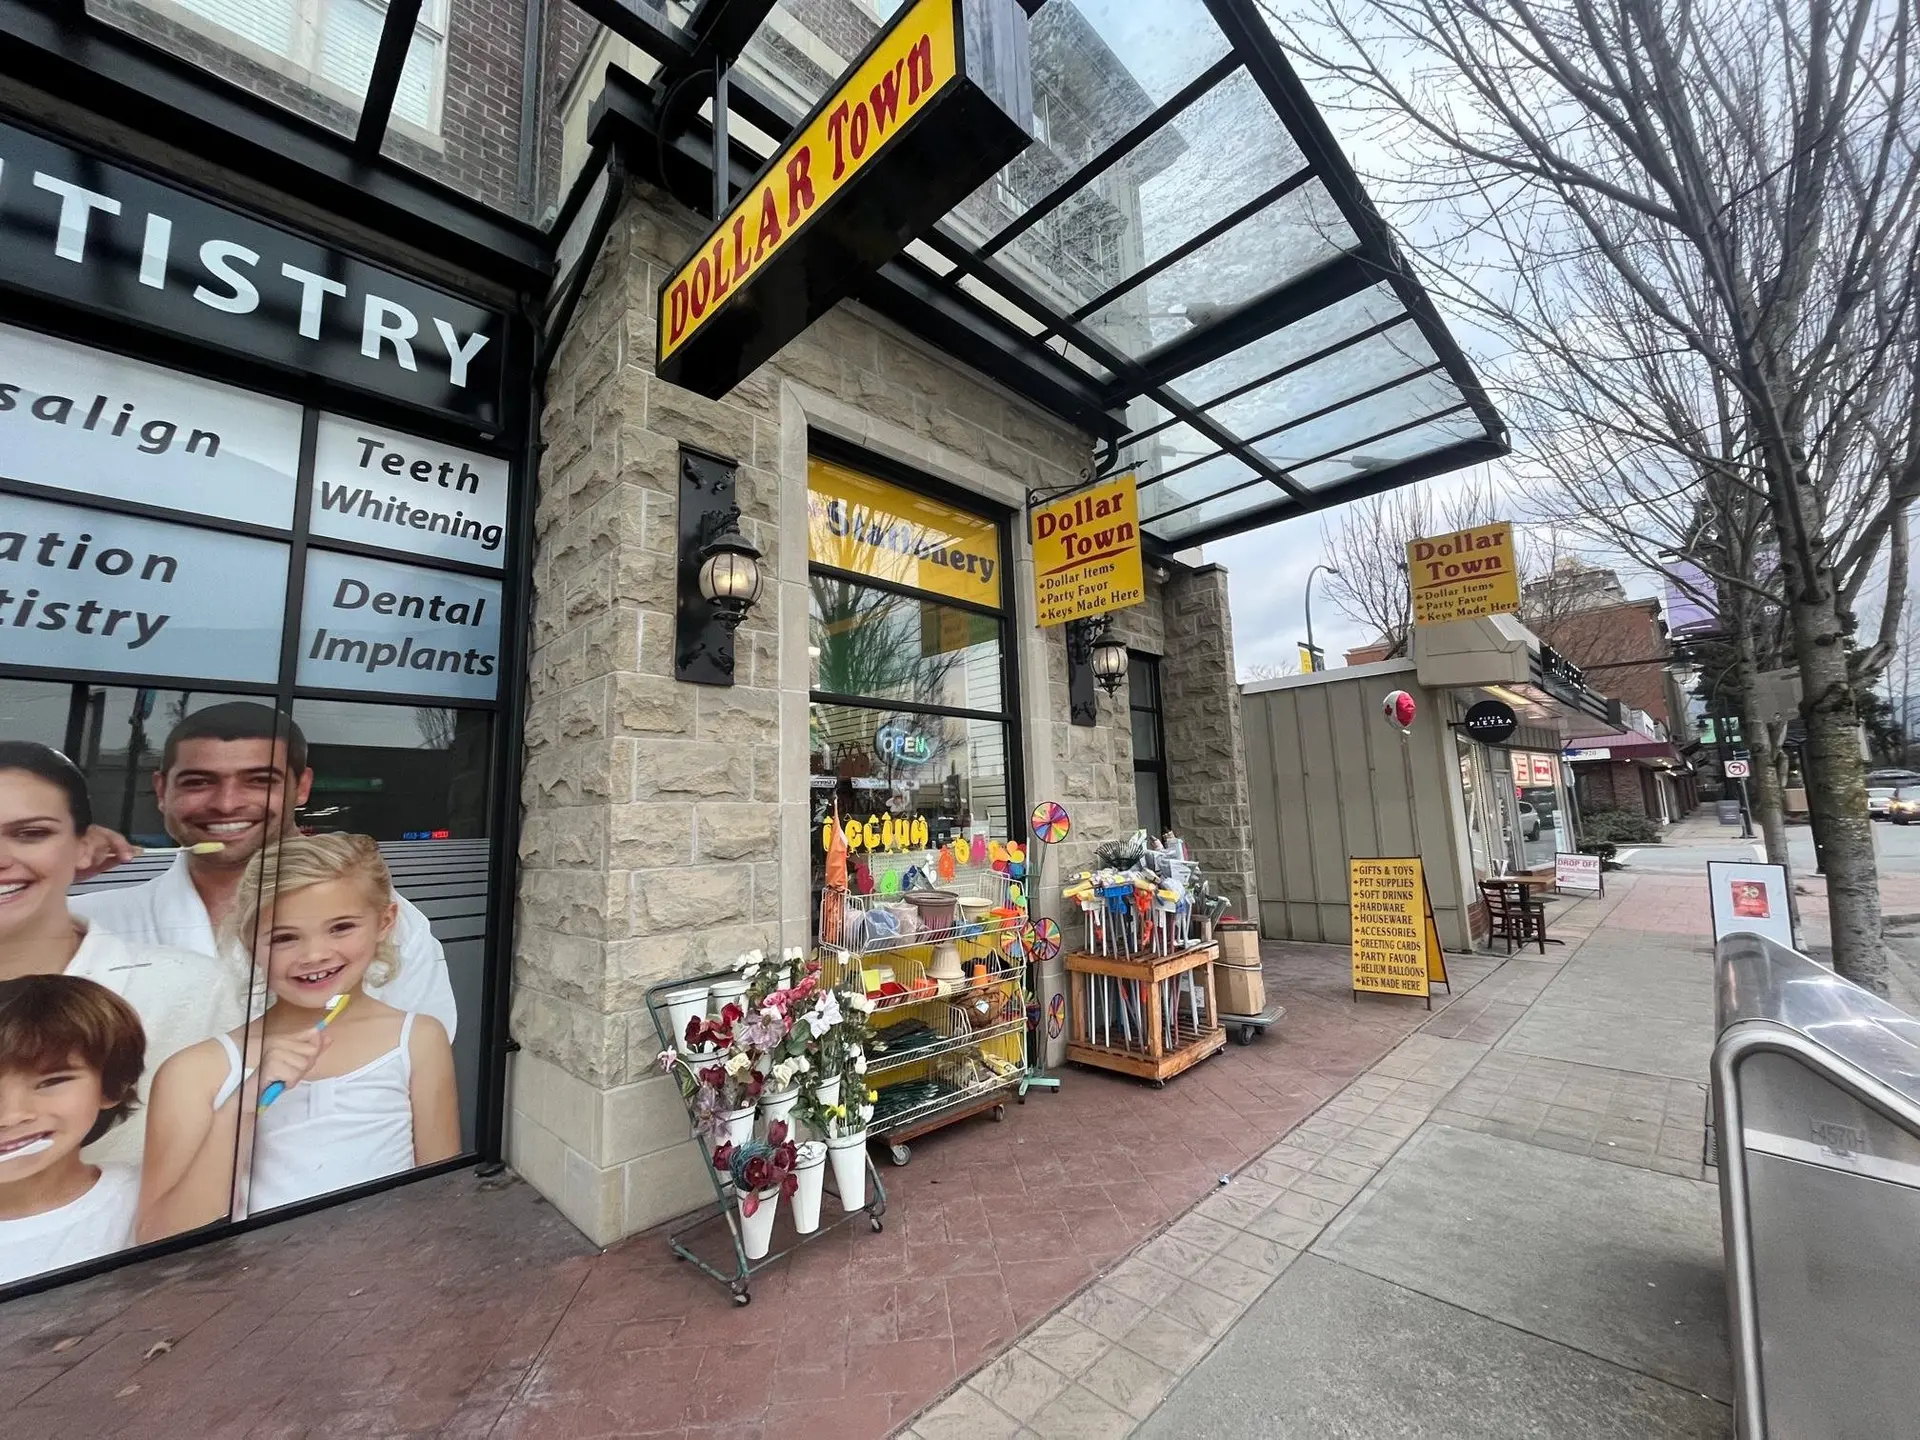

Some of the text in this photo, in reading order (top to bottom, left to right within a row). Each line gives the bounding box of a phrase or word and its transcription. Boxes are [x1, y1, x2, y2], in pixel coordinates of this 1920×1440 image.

[669, 145, 815, 346] DOLLAR
[0, 158, 490, 388] TISTRY
[357, 436, 480, 494] Teeth
[320, 481, 503, 550] Whitening
[1036, 493, 1124, 539] Dollar
[1061, 522, 1134, 560] Town
[1414, 532, 1505, 561] Dollar
[0, 531, 178, 583] ation
[1046, 564, 1115, 589] Dollar Items
[1426, 555, 1502, 580] Town
[1047, 581, 1108, 604] Party Favor
[1425, 582, 1494, 600] Dollar Items
[332, 577, 485, 627] Dental
[1048, 589, 1139, 620] Keys Made Here
[1426, 595, 1488, 611] Party Favor
[1427, 601, 1518, 621] Keys Made Here
[309, 628, 496, 677] Implants
[1469, 718, 1512, 727] PIETRA
[883, 735, 925, 753] OPEN
[1359, 865, 1414, 875] GIFTS & TOYS
[1558, 858, 1580, 867] DROP
[1359, 877, 1414, 888] PET SUPPLIES
[1359, 889, 1414, 900] SOFT DRINKS
[1360, 902, 1406, 912] HARDWARE
[1360, 914, 1414, 925] HOUSEWARE
[1360, 927, 1417, 938] ACCESSORIES
[1360, 938, 1421, 951] GREETING CARDS
[1361, 951, 1417, 964] PARTY FAVOR
[1361, 963, 1425, 978] HELIUM BALLOONS
[1361, 976, 1421, 991] KEYS MADE HERE
